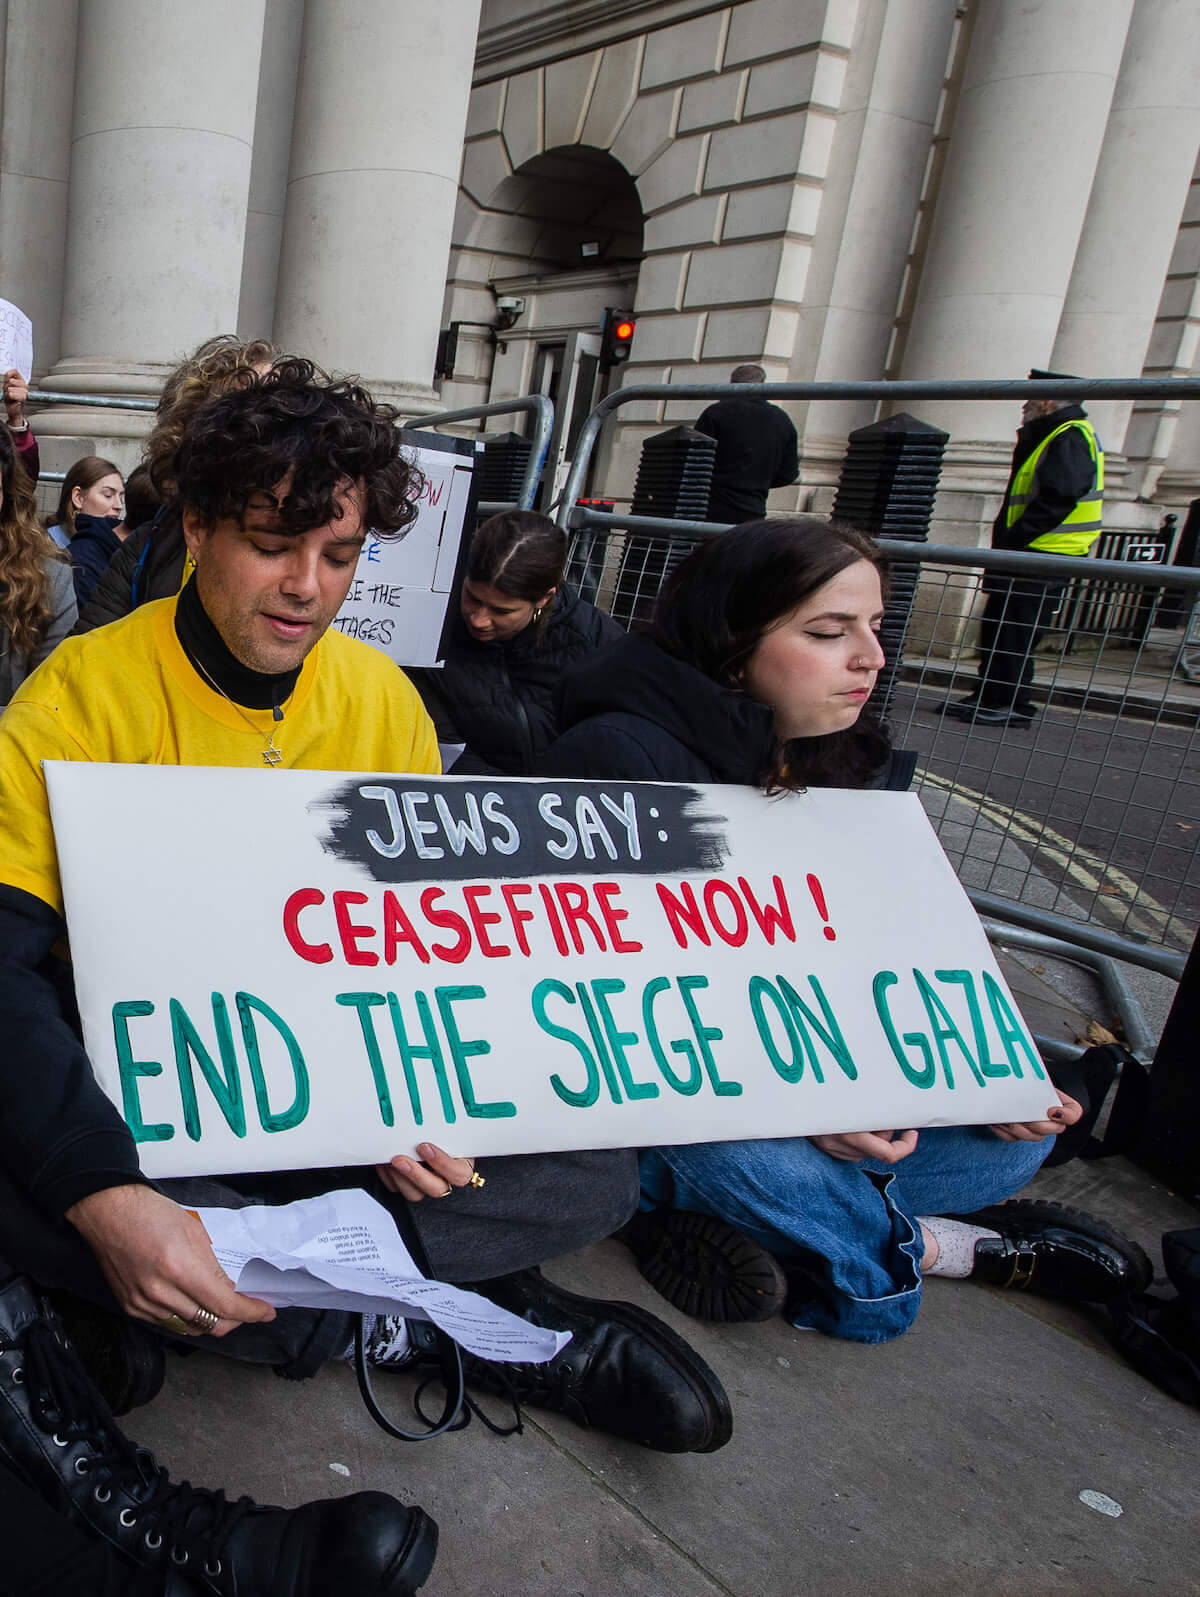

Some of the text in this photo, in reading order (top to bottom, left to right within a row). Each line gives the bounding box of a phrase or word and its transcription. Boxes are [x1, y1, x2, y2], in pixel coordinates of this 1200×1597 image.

[367, 584, 404, 607] THE
[358, 786, 670, 861] JEWS SAY:
[282, 881, 643, 967] CEASEFIRE
[112, 967, 1046, 1144] END THE SIEGE ON GAZA
